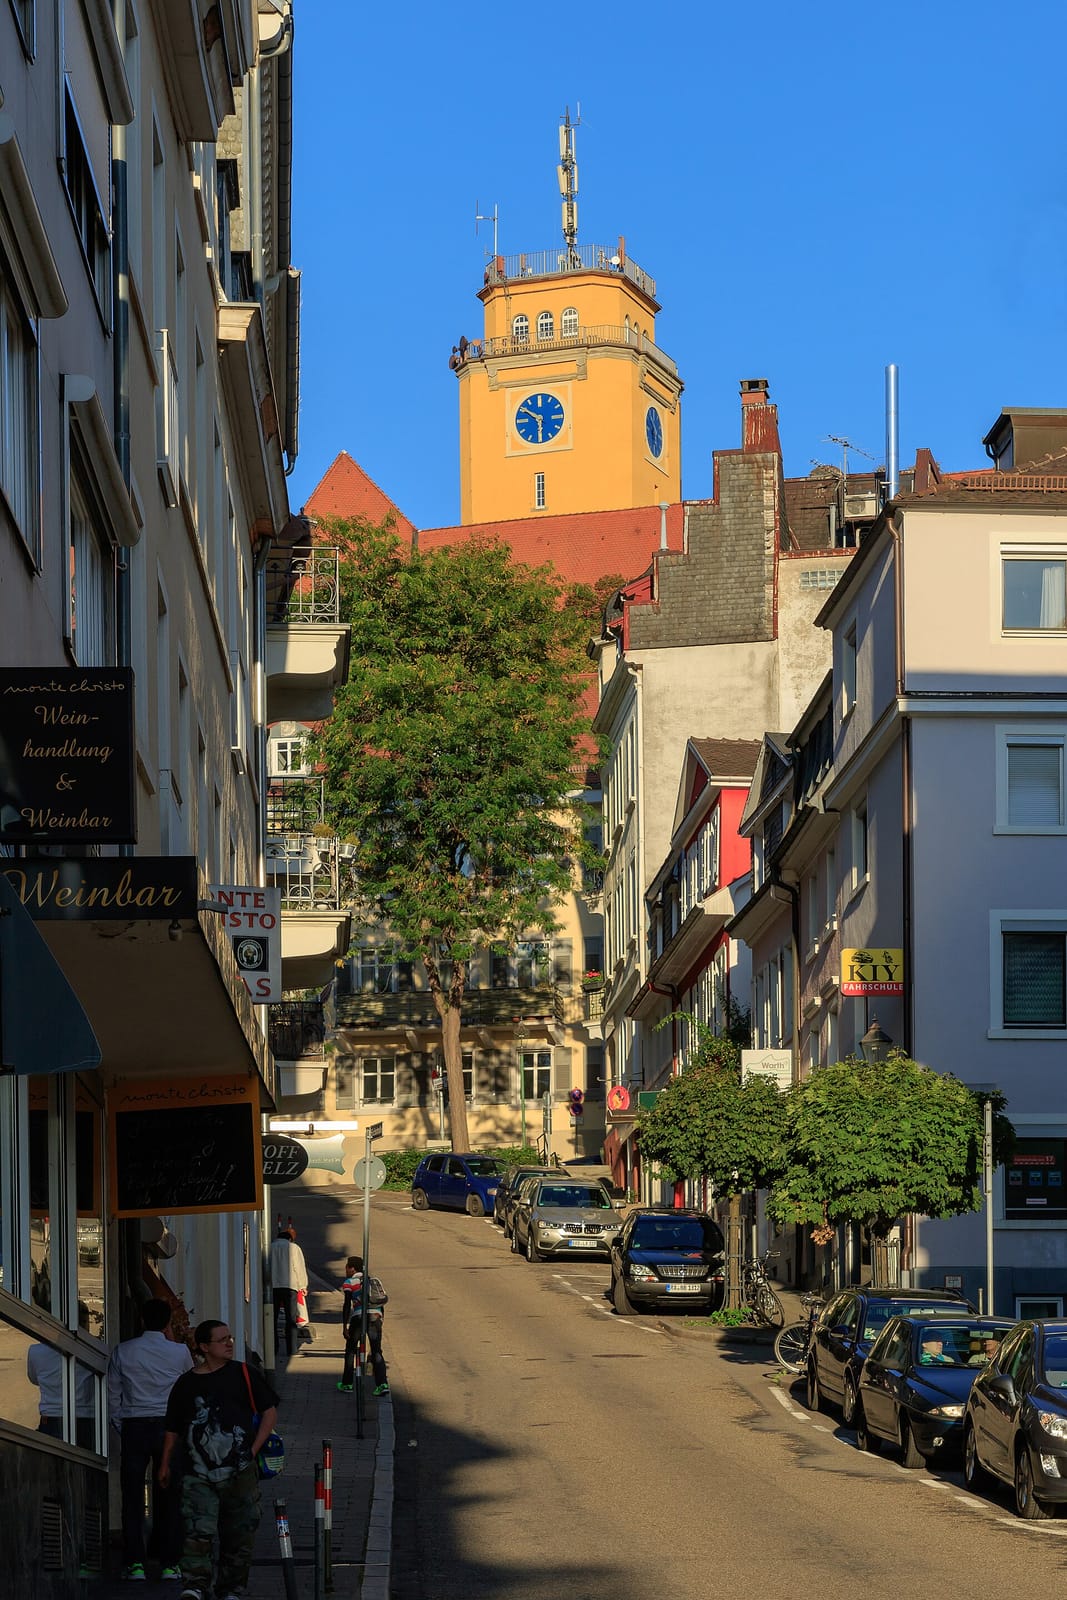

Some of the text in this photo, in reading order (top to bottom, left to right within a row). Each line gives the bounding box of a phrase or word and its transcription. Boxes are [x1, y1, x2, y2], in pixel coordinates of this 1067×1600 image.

[34, 705, 100, 726] Wein-
[22, 738, 113, 764] handlung
[56, 772, 77, 791] &
[20, 807, 113, 829] Weinbar
[2, 868, 183, 909] Weinbar
[848, 965, 901, 982] KIY
[843, 983, 904, 991] FAHRSCHULE
